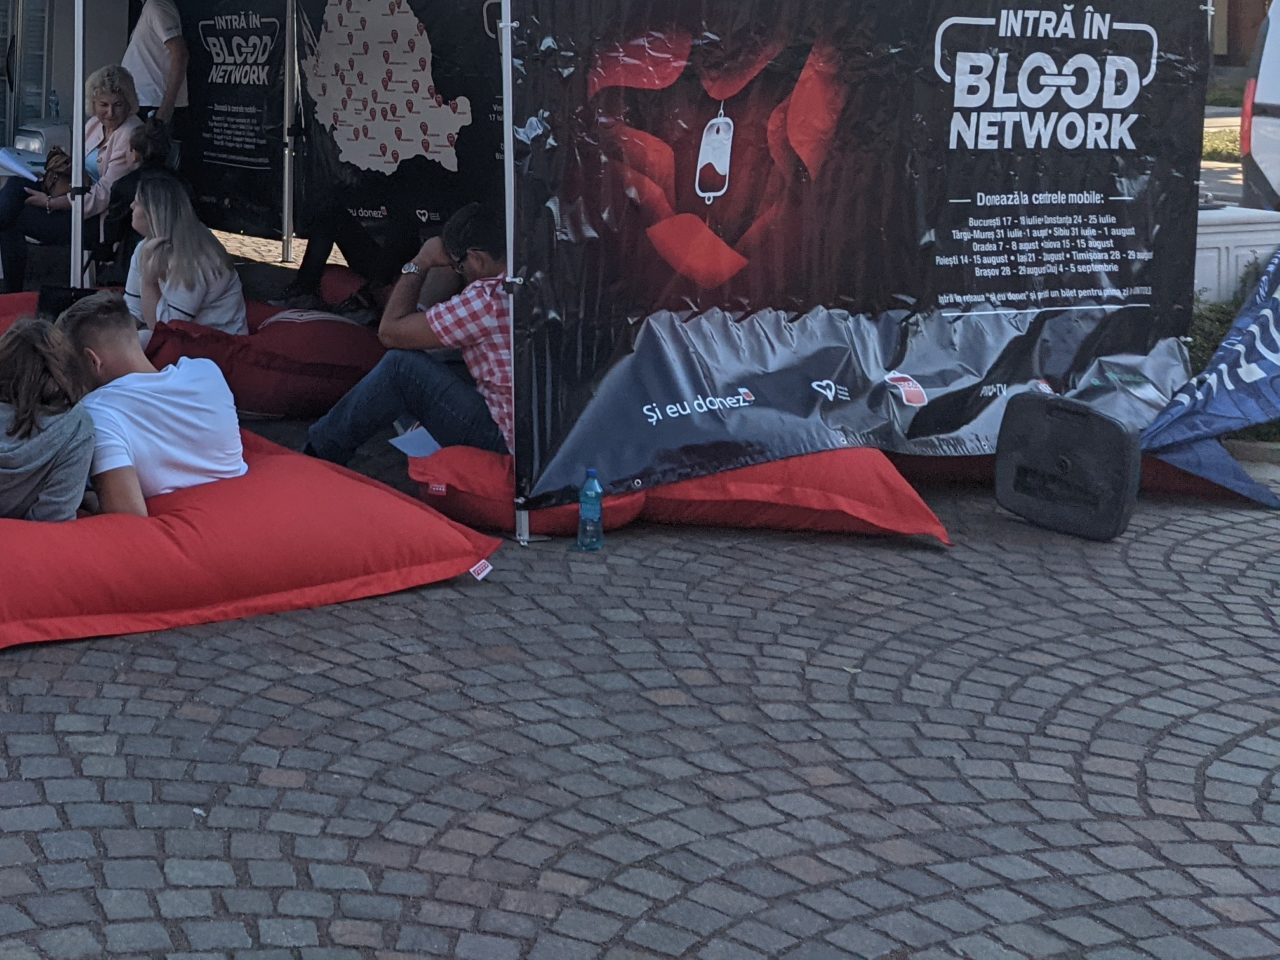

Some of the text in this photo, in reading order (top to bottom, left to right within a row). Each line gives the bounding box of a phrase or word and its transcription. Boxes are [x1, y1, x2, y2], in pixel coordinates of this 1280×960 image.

[998, 3, 1111, 40] INTRĂ ÎN
[206, 35, 272, 64] BLOOD
[208, 65, 269, 86] NETWORK
[953, 51, 1141, 109] BLOOD
[949, 111, 1139, 150] NETWORK
[1068, 191, 1105, 204] mobile:
[1002, 217, 1012, 226] 17
[1073, 215, 1082, 224] 24
[1088, 215, 1097, 224] 25
[996, 229, 1004, 238] 31
[1070, 227, 1078, 236] 31
[998, 242, 1003, 251] 7
[1011, 241, 1017, 250] 8
[1062, 240, 1070, 248] 15
[1076, 239, 1086, 248] 15
[960, 255, 968, 264] 14
[973, 255, 981, 264] 15
[983, 254, 1008, 265] august
[1110, 251, 1120, 259] 28
[642, 393, 749, 426] Și eu donez
